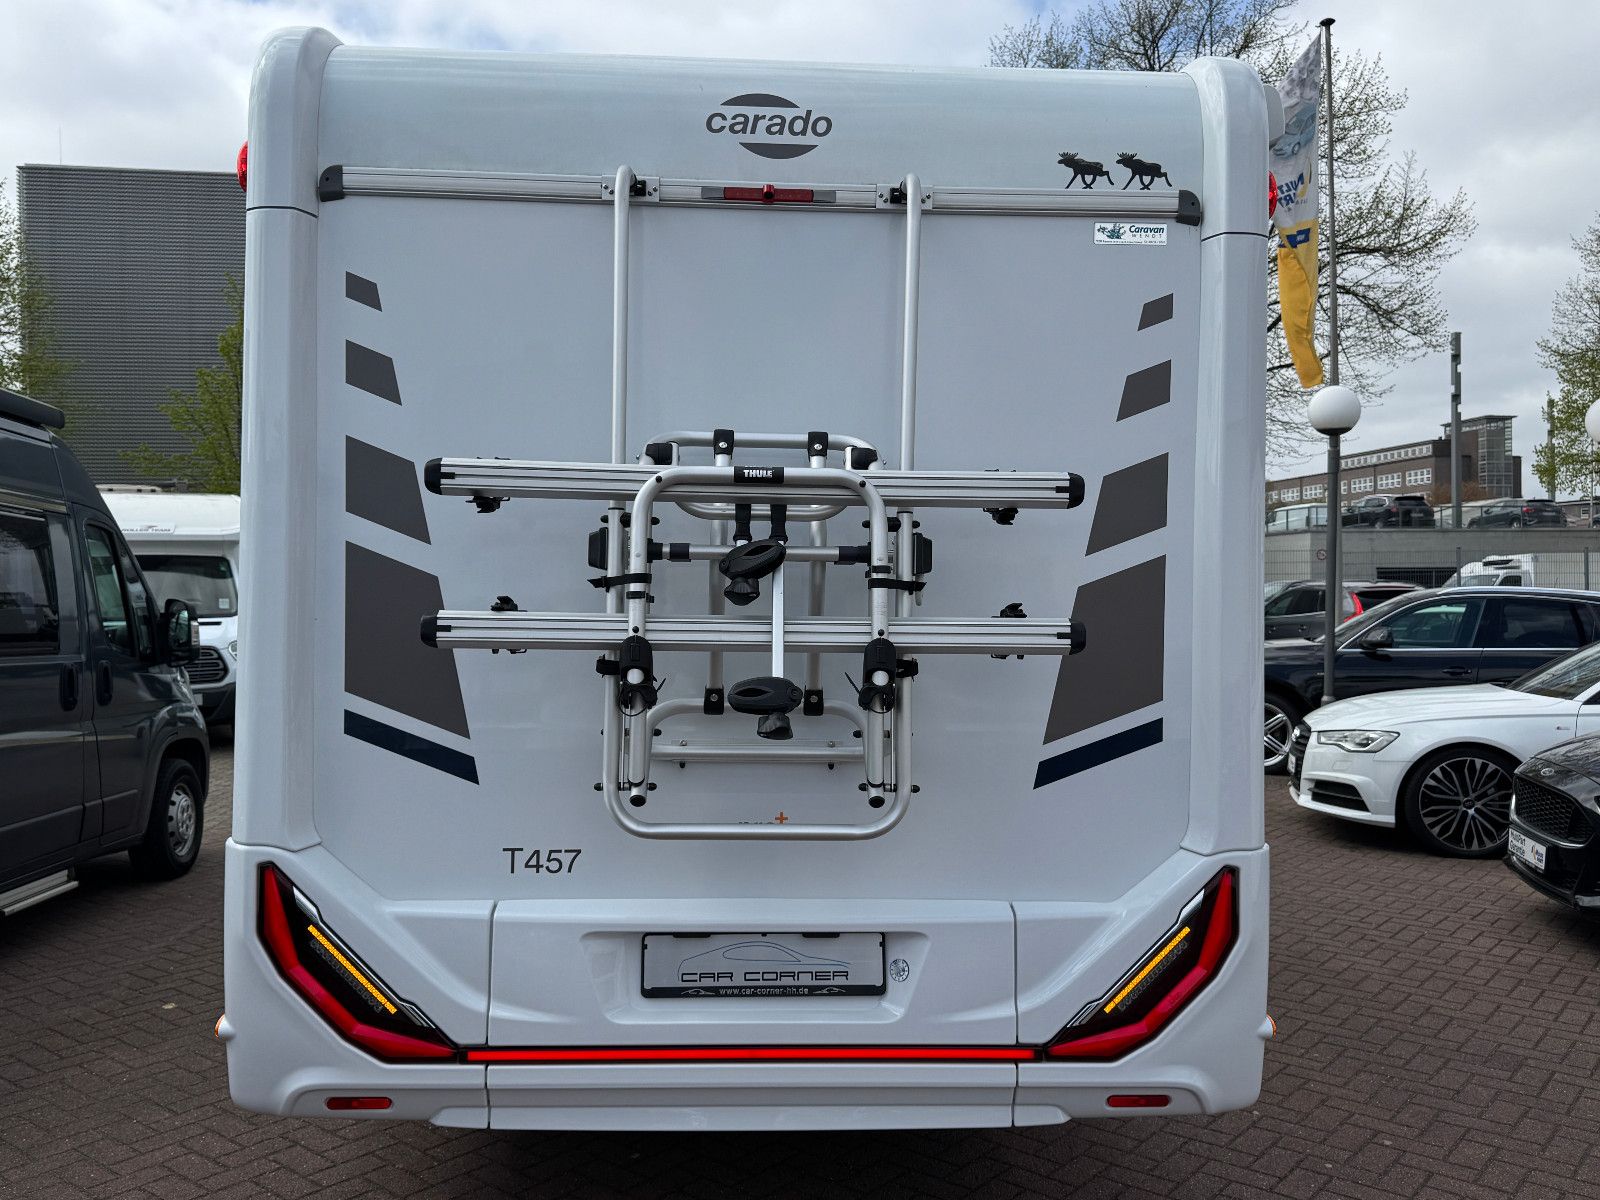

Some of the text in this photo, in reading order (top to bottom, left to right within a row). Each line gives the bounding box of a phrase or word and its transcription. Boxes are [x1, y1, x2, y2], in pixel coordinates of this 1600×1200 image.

[705, 109, 833, 138] carado
[1129, 224, 1165, 234] Caravan
[743, 469, 773, 478] THULE
[502, 847, 582, 874] T457
[681, 970, 849, 983] CAR CORNER
[719, 986, 809, 996] www.car-corner-hh.de
